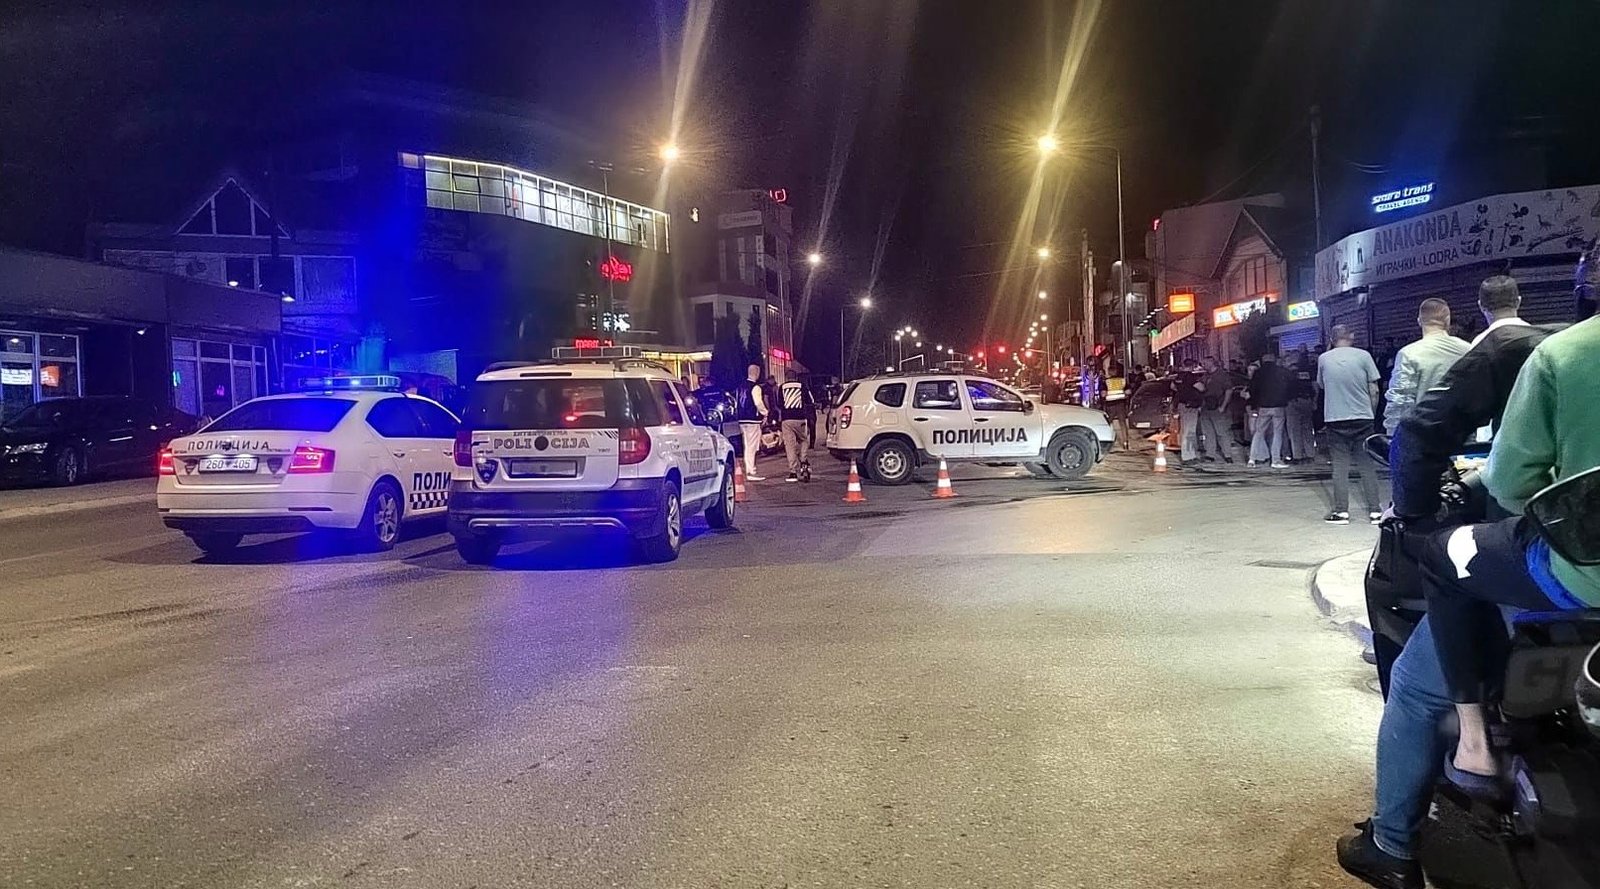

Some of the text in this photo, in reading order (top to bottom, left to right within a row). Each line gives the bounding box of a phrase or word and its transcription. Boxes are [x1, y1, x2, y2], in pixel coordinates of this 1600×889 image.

[1403, 183, 1434, 197] trans
[1373, 210, 1462, 256] ANAKONDA
[933, 427, 1028, 446] ПОЛИЦИЈА
